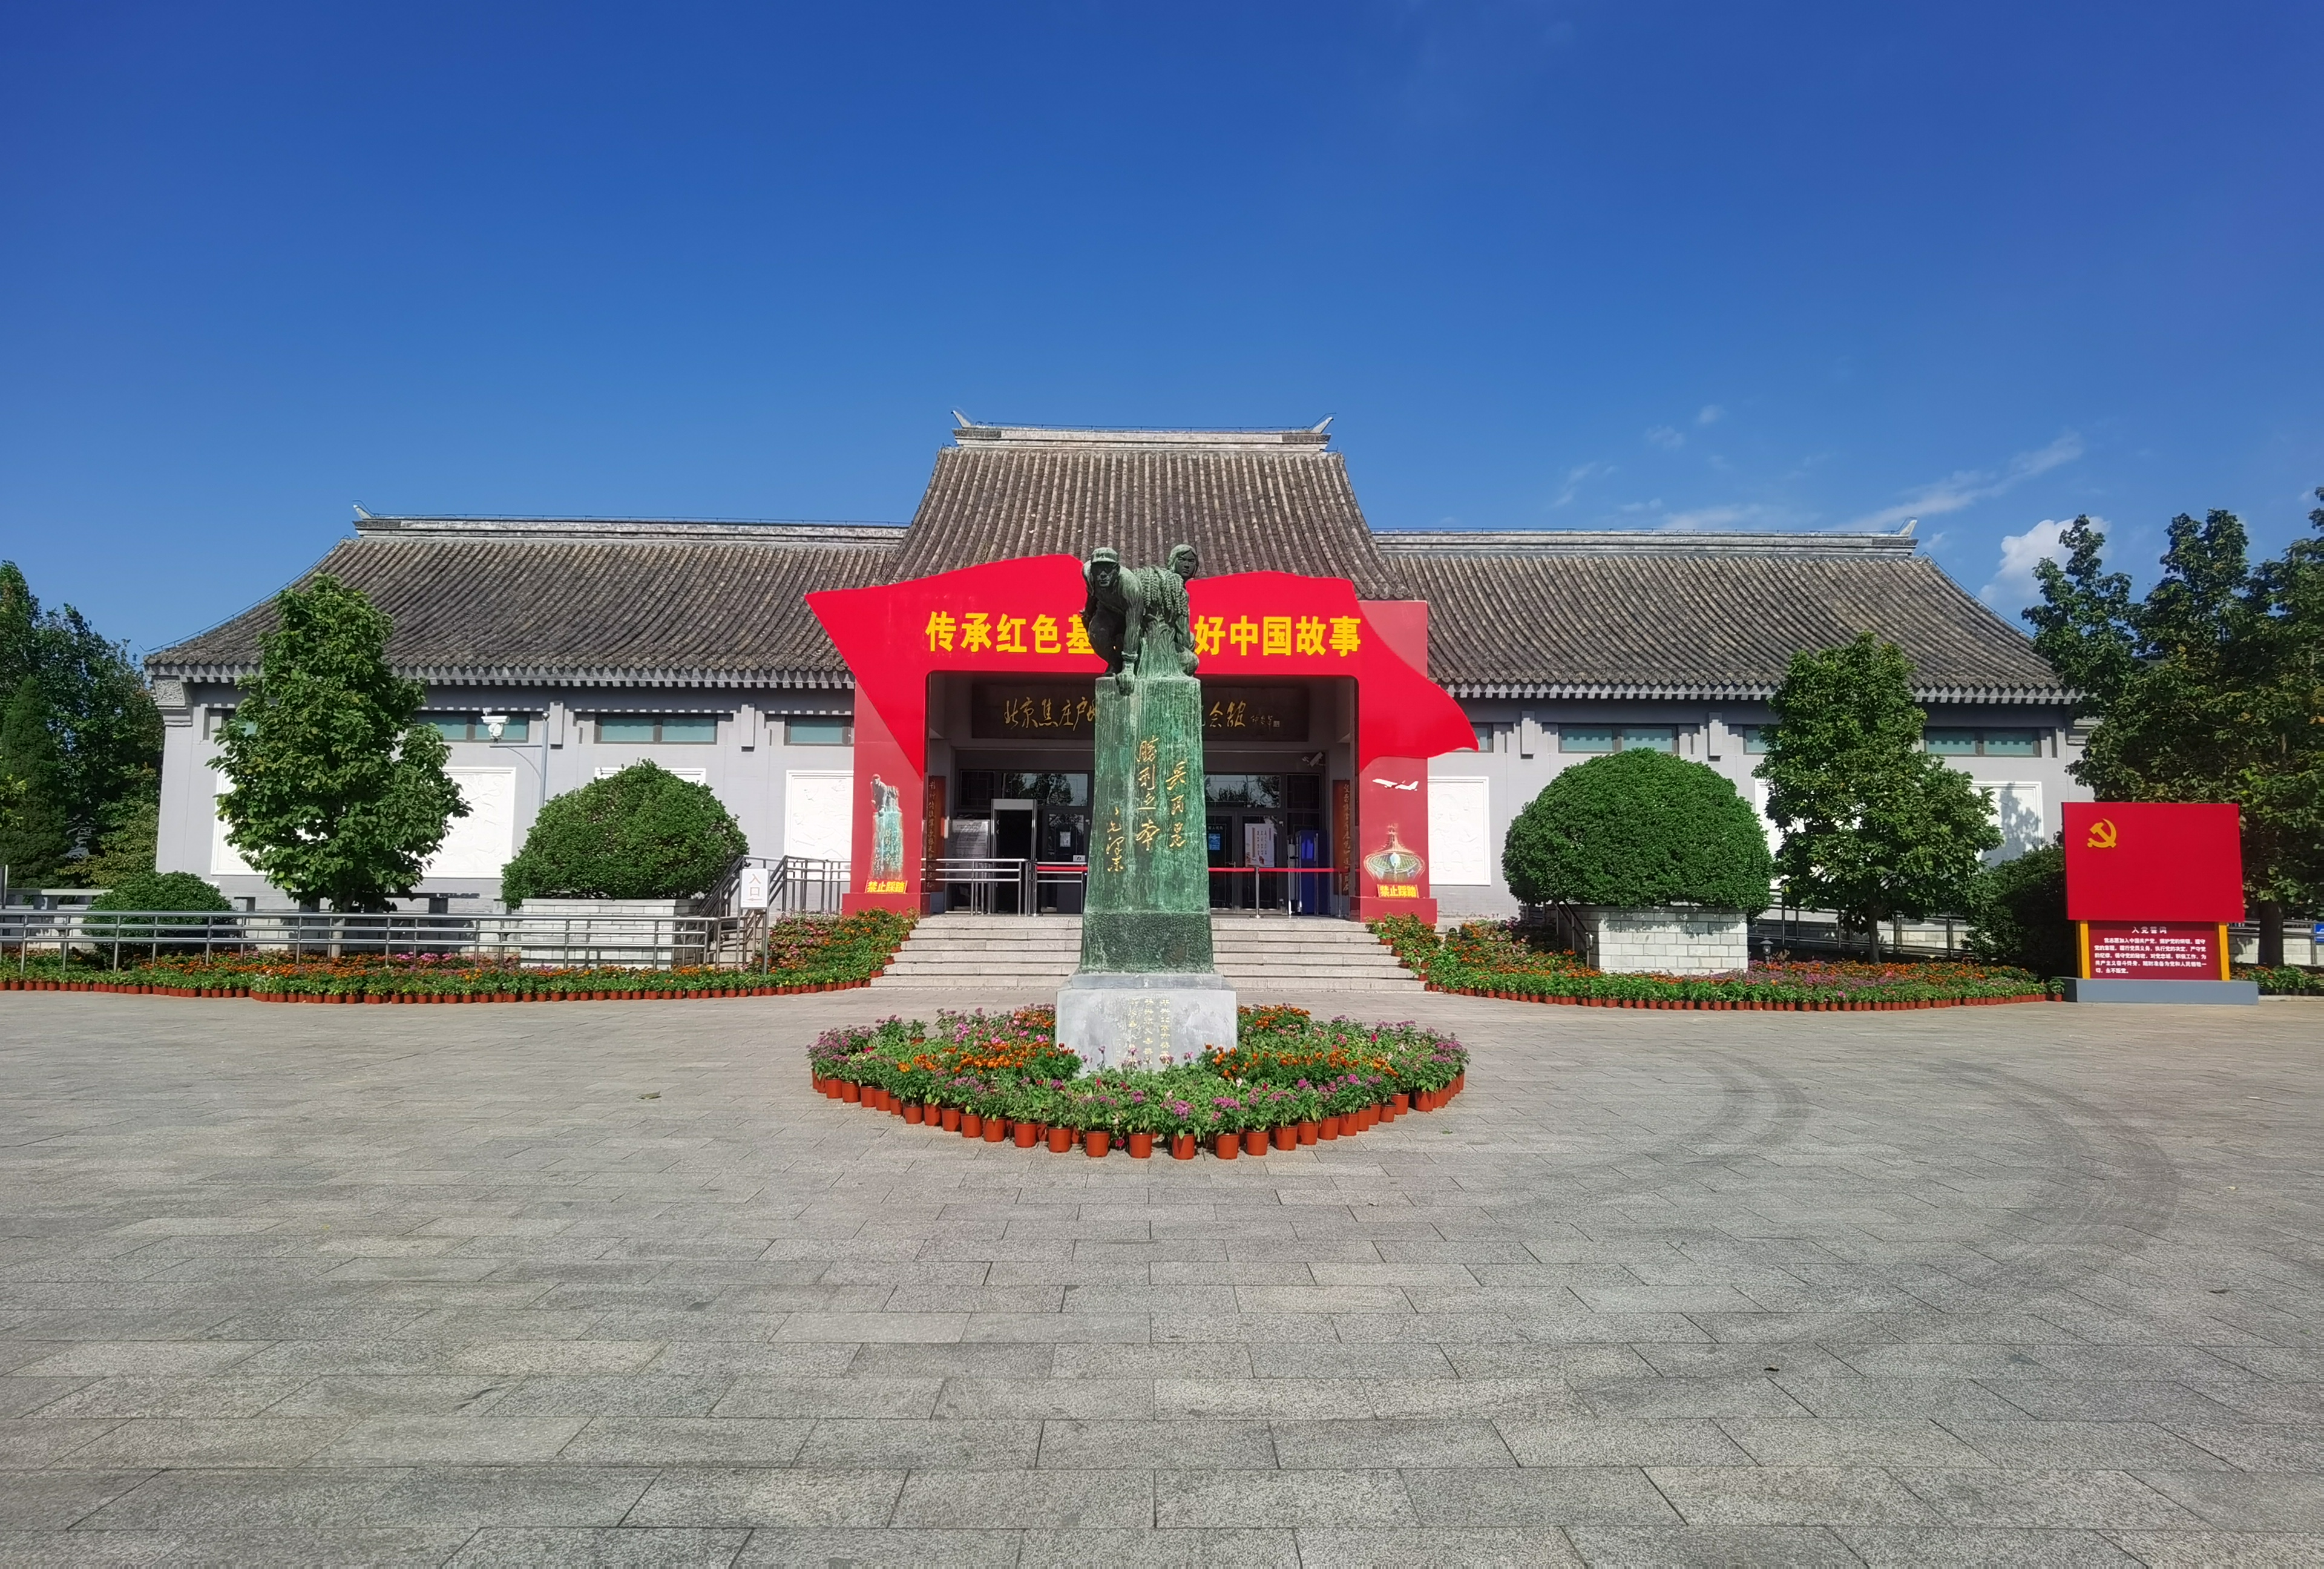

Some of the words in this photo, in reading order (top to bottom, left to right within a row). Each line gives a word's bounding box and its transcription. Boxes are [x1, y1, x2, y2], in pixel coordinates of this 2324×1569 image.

[925, 611, 1095, 654] 传承红色基
[1193, 615, 1361, 657] 好中国故事
[749, 873, 761, 897] 入口
[866, 880, 905, 893] 禁止踩踏
[1379, 884, 1417, 898] 禁止踩踏
[2131, 926, 2168, 934] 入党誓词
